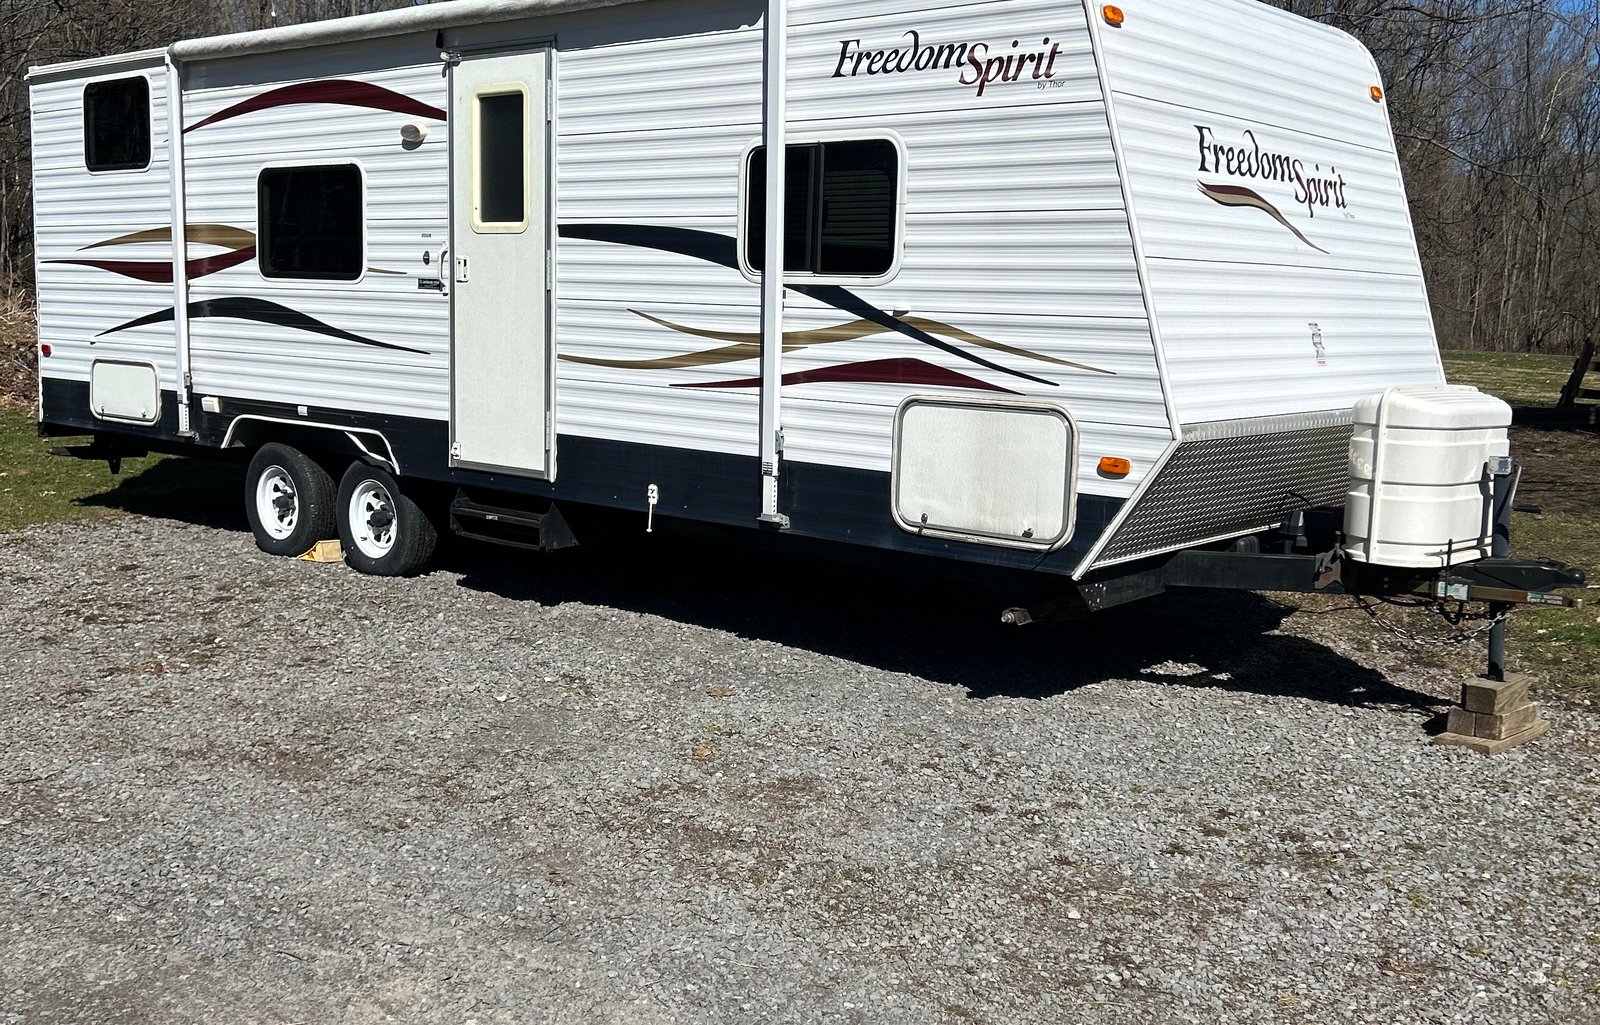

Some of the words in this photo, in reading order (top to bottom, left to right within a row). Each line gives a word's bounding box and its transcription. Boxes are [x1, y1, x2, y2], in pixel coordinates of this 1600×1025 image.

[831, 30, 968, 78] Freedom
[958, 36, 1063, 97] Spirit
[1037, 80, 1047, 90] by
[1048, 79, 1066, 88] Thor
[1193, 124, 1295, 183] Freedom
[1292, 158, 1348, 218] Spirit
